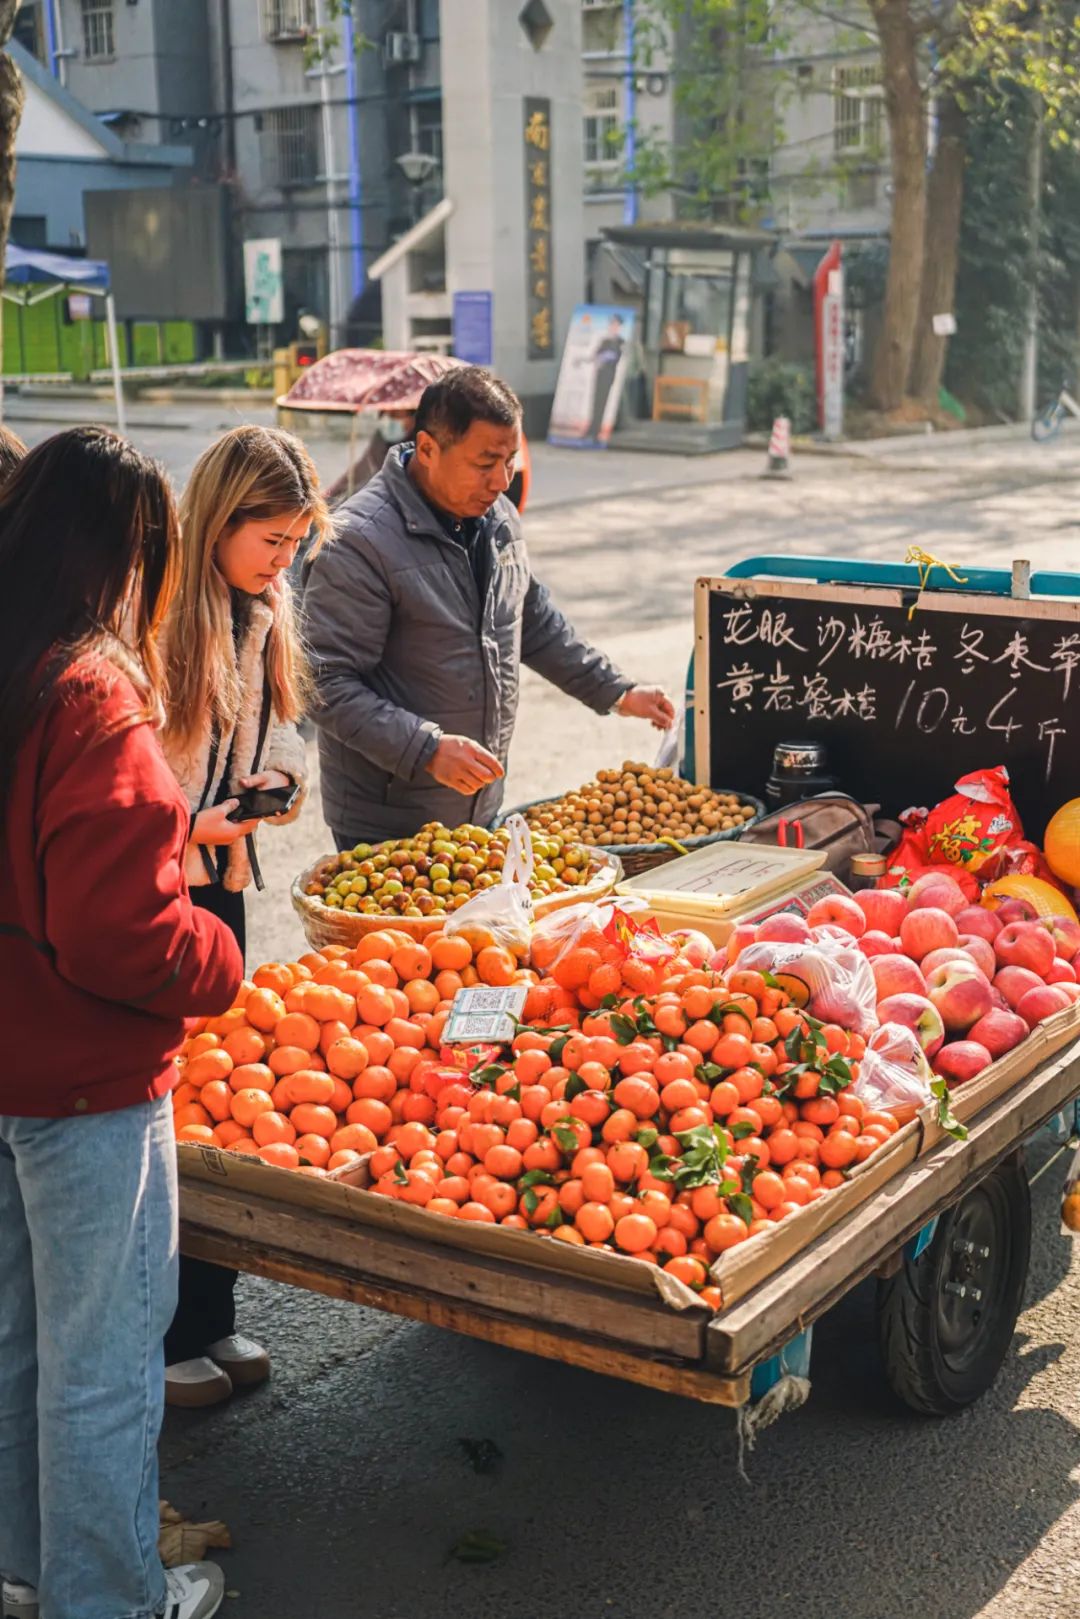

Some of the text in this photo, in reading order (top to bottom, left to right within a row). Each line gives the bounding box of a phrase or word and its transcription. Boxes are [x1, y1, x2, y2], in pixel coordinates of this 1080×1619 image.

[722, 602, 809, 653] 龙眼
[816, 613, 938, 670] 沙糖桔
[716, 659, 877, 721] 黄岩蜜桔
